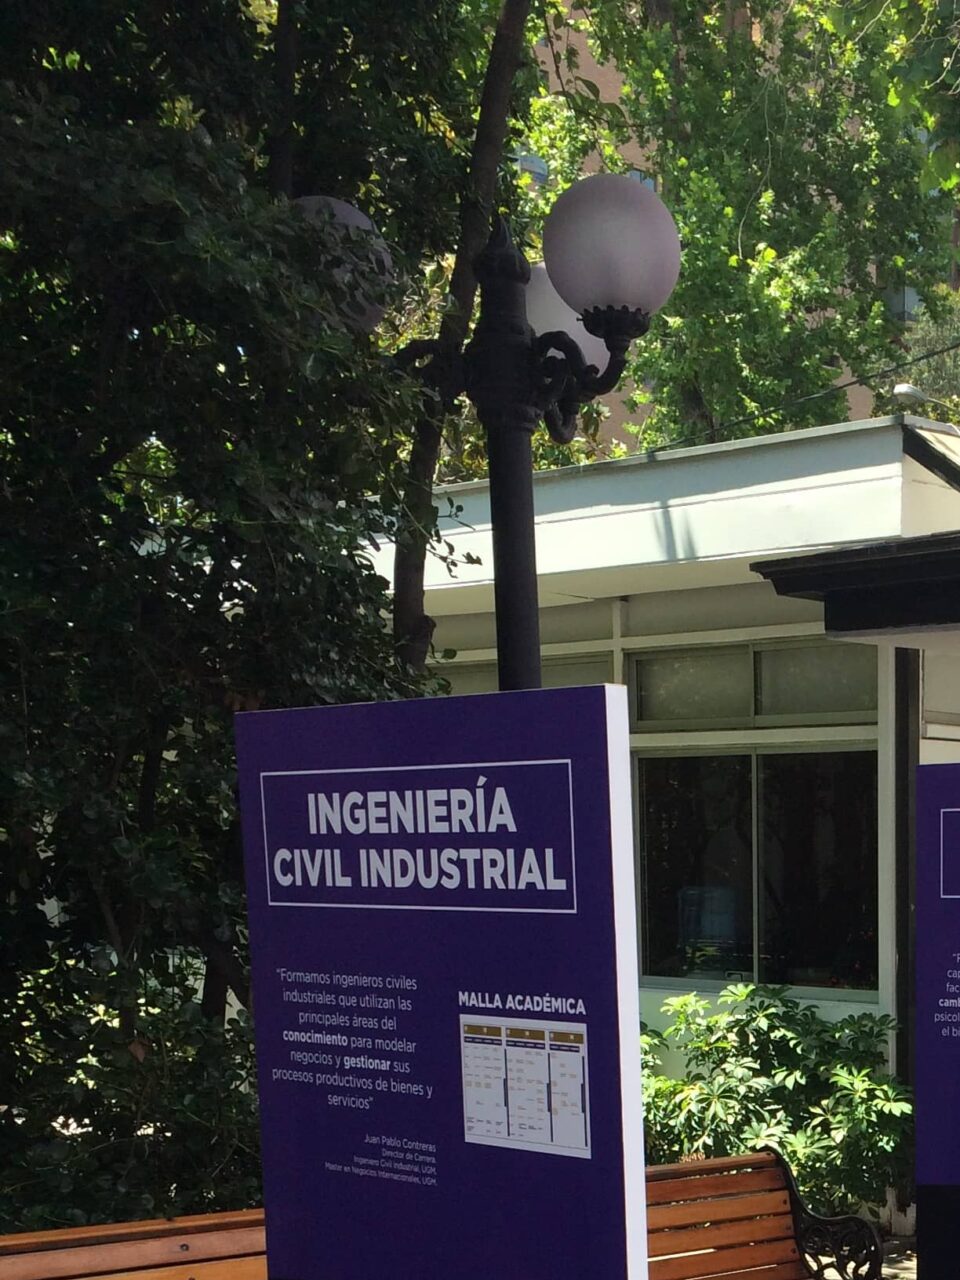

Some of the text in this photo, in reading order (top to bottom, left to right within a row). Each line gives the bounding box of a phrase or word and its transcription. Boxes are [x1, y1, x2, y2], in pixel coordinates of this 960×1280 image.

[307, 775, 517, 835] INGENIERÍA
[273, 848, 567, 890] CIVIL INDUSTRIAL
[333, 970, 383, 988] ingenieros
[386, 974, 417, 990] civiles
[283, 988, 412, 1011] industriales que utilizan las
[458, 991, 586, 1015] MALLA ACADÉMICA
[299, 1011, 397, 1031] principales áreas del
[941, 1026, 950, 1036] el
[283, 1030, 416, 1053] conocimiento para modelar
[290, 1050, 410, 1073] negocios y gestionar sus
[272, 1068, 433, 1098] procesos productivos de bienes y
[364, 1133, 436, 1152] Juan Pablo Contreras
